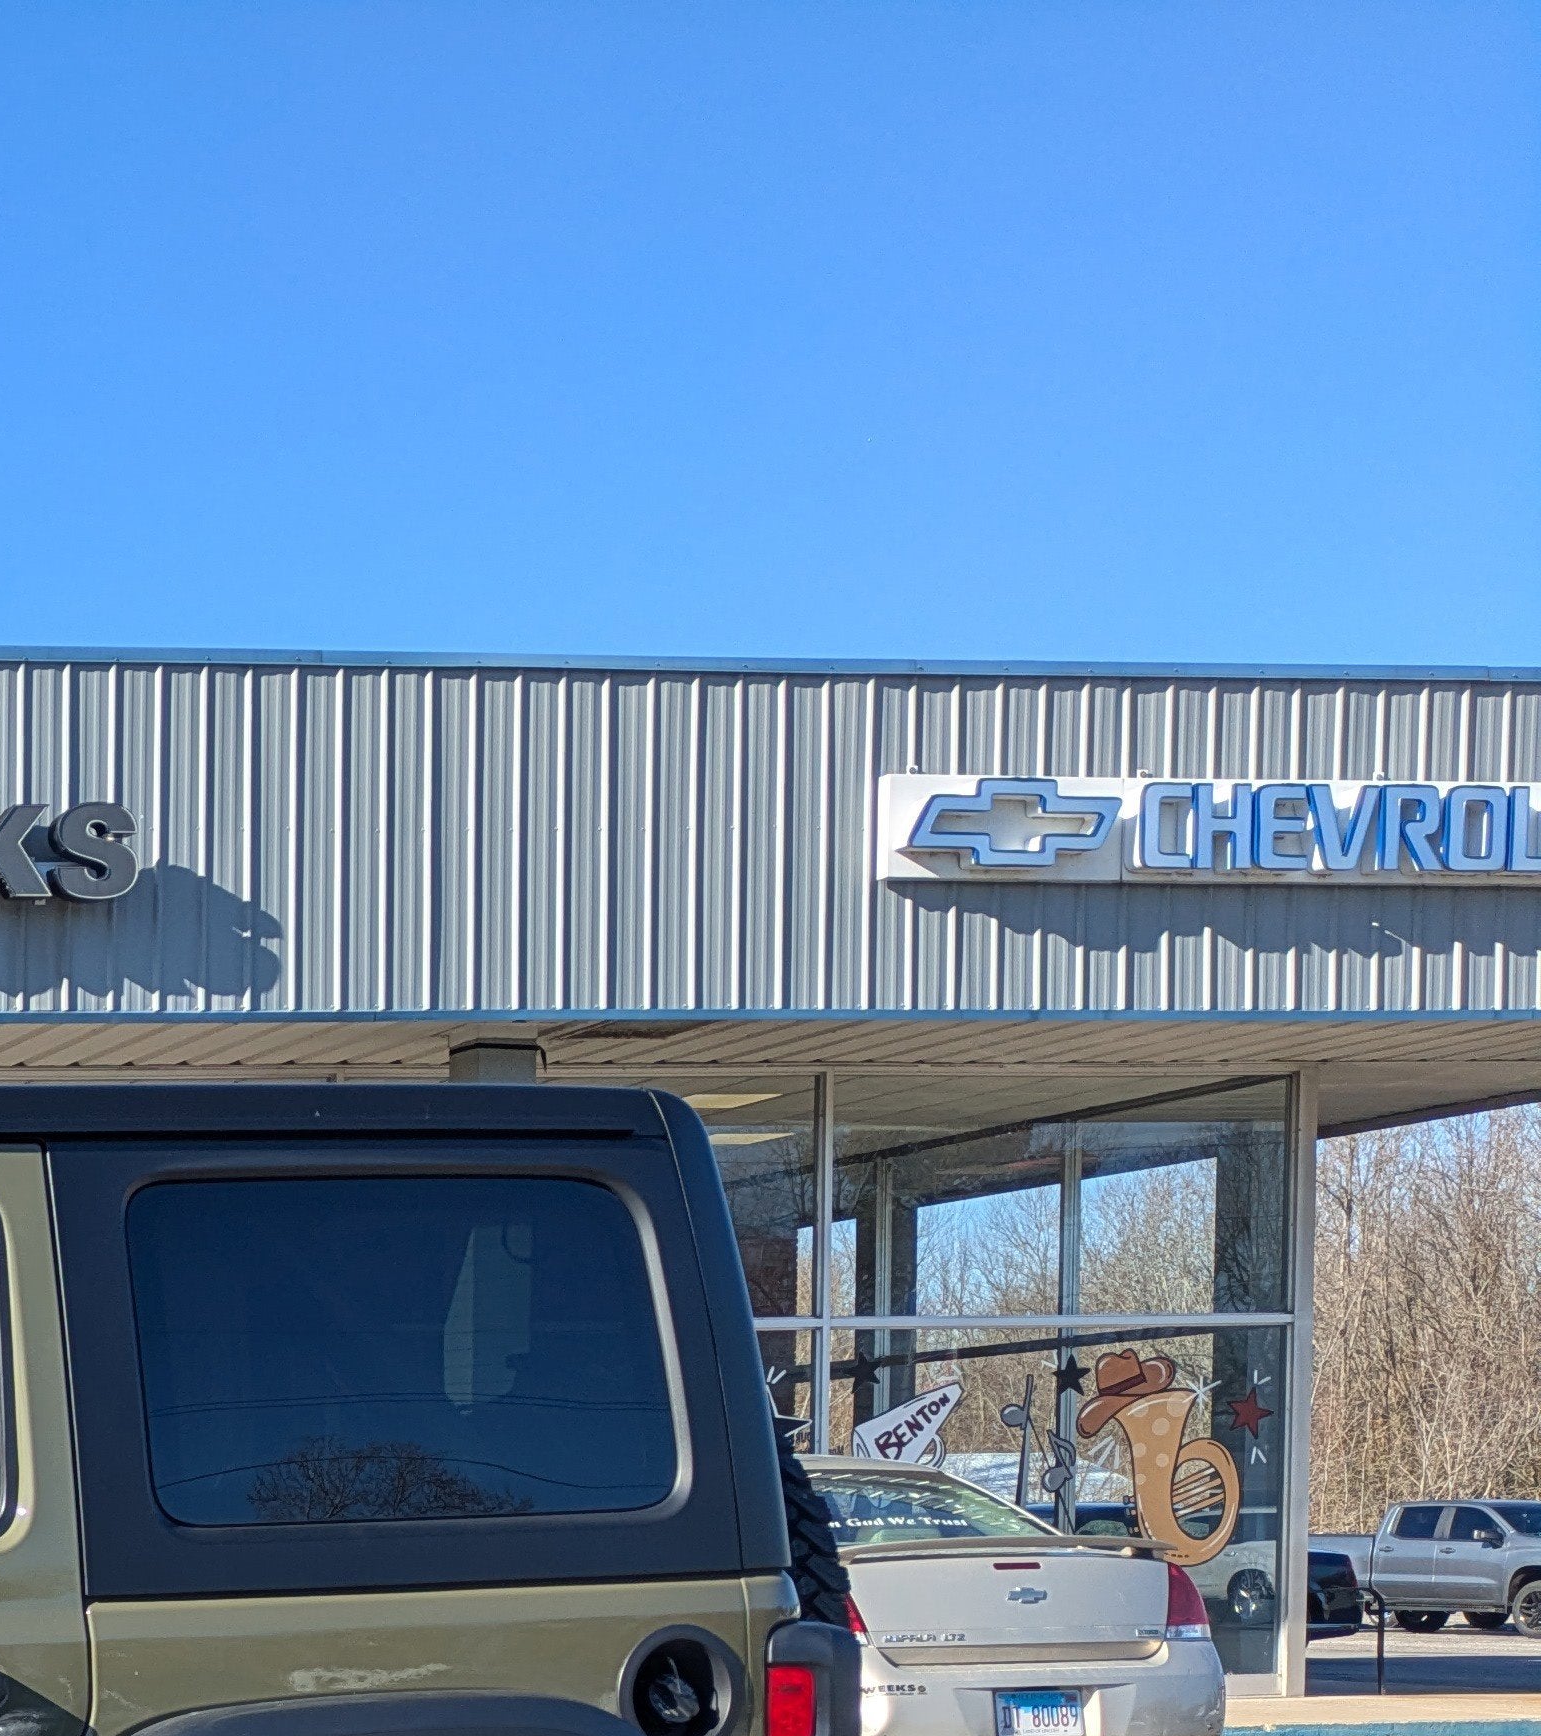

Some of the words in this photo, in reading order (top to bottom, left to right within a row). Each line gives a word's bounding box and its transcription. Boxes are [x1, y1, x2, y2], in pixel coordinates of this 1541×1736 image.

[874, 1392, 951, 1460] BENTON
[846, 1517, 885, 1527] God
[887, 1516, 916, 1526] We
[917, 1515, 968, 1527] Trust
[1031, 1704, 1078, 1728] 80089
